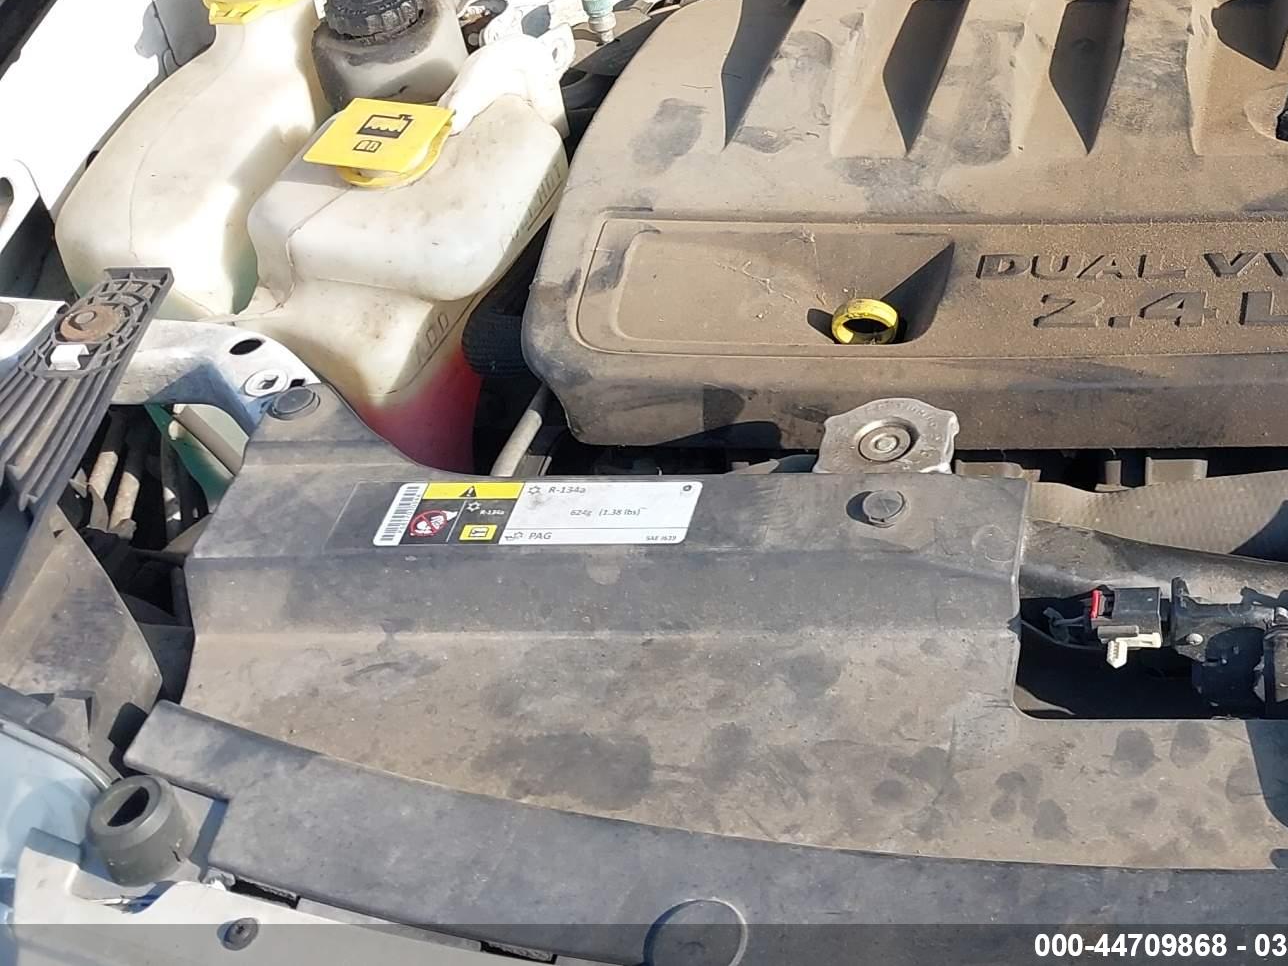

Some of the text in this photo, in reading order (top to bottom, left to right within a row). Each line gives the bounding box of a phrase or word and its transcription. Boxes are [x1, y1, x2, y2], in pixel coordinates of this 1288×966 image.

[976, 252, 1186, 280] DUAL
[548, 486, 586, 494] R-134a
[528, 532, 552, 540] PAG
